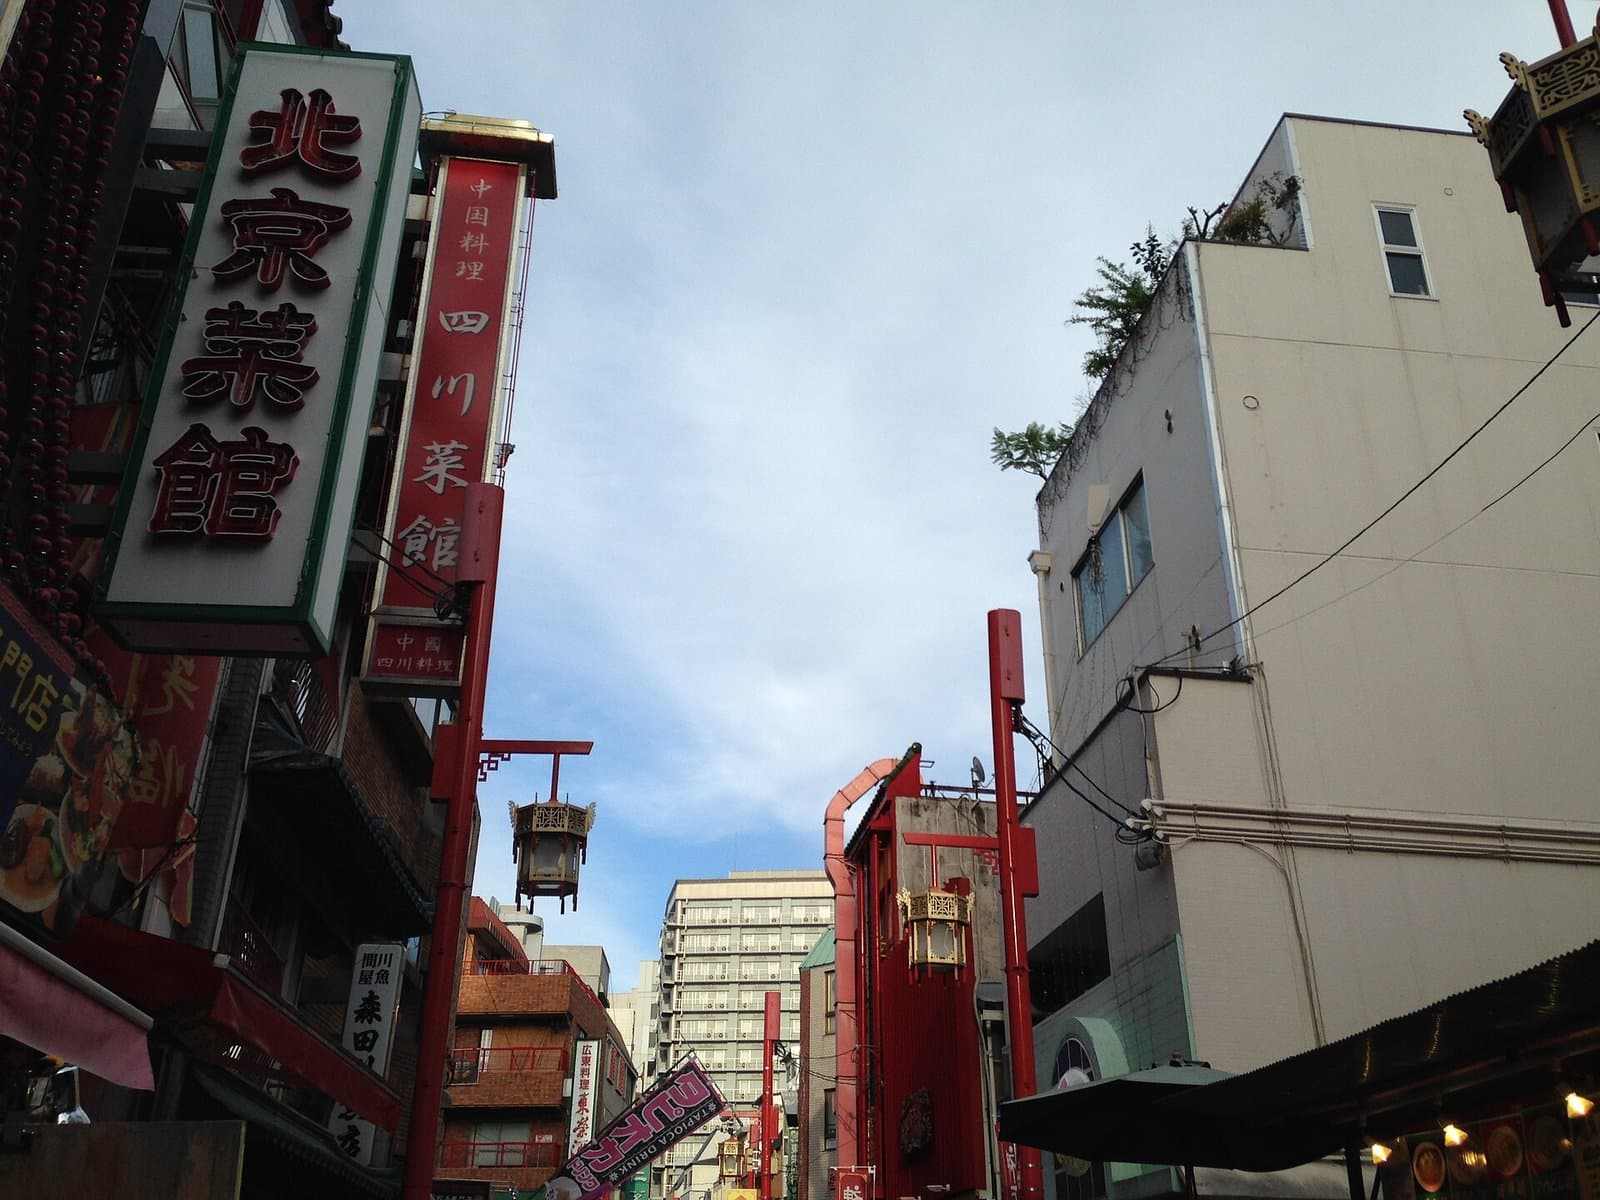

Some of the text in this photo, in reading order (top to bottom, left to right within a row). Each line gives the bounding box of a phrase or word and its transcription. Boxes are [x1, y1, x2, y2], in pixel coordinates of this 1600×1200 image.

[148, 87, 363, 544] 北京菜館
[397, 178, 492, 572] 中国料理 四川菜館
[376, 656, 455, 674] 四川料理
[396, 632, 442, 653] 中國
[375, 952, 393, 985] 川魚
[579, 1044, 593, 1091] 広東料理
[581, 1070, 711, 1173] タピオカ
[619, 1107, 710, 1176] TAPIOCA DRINK
